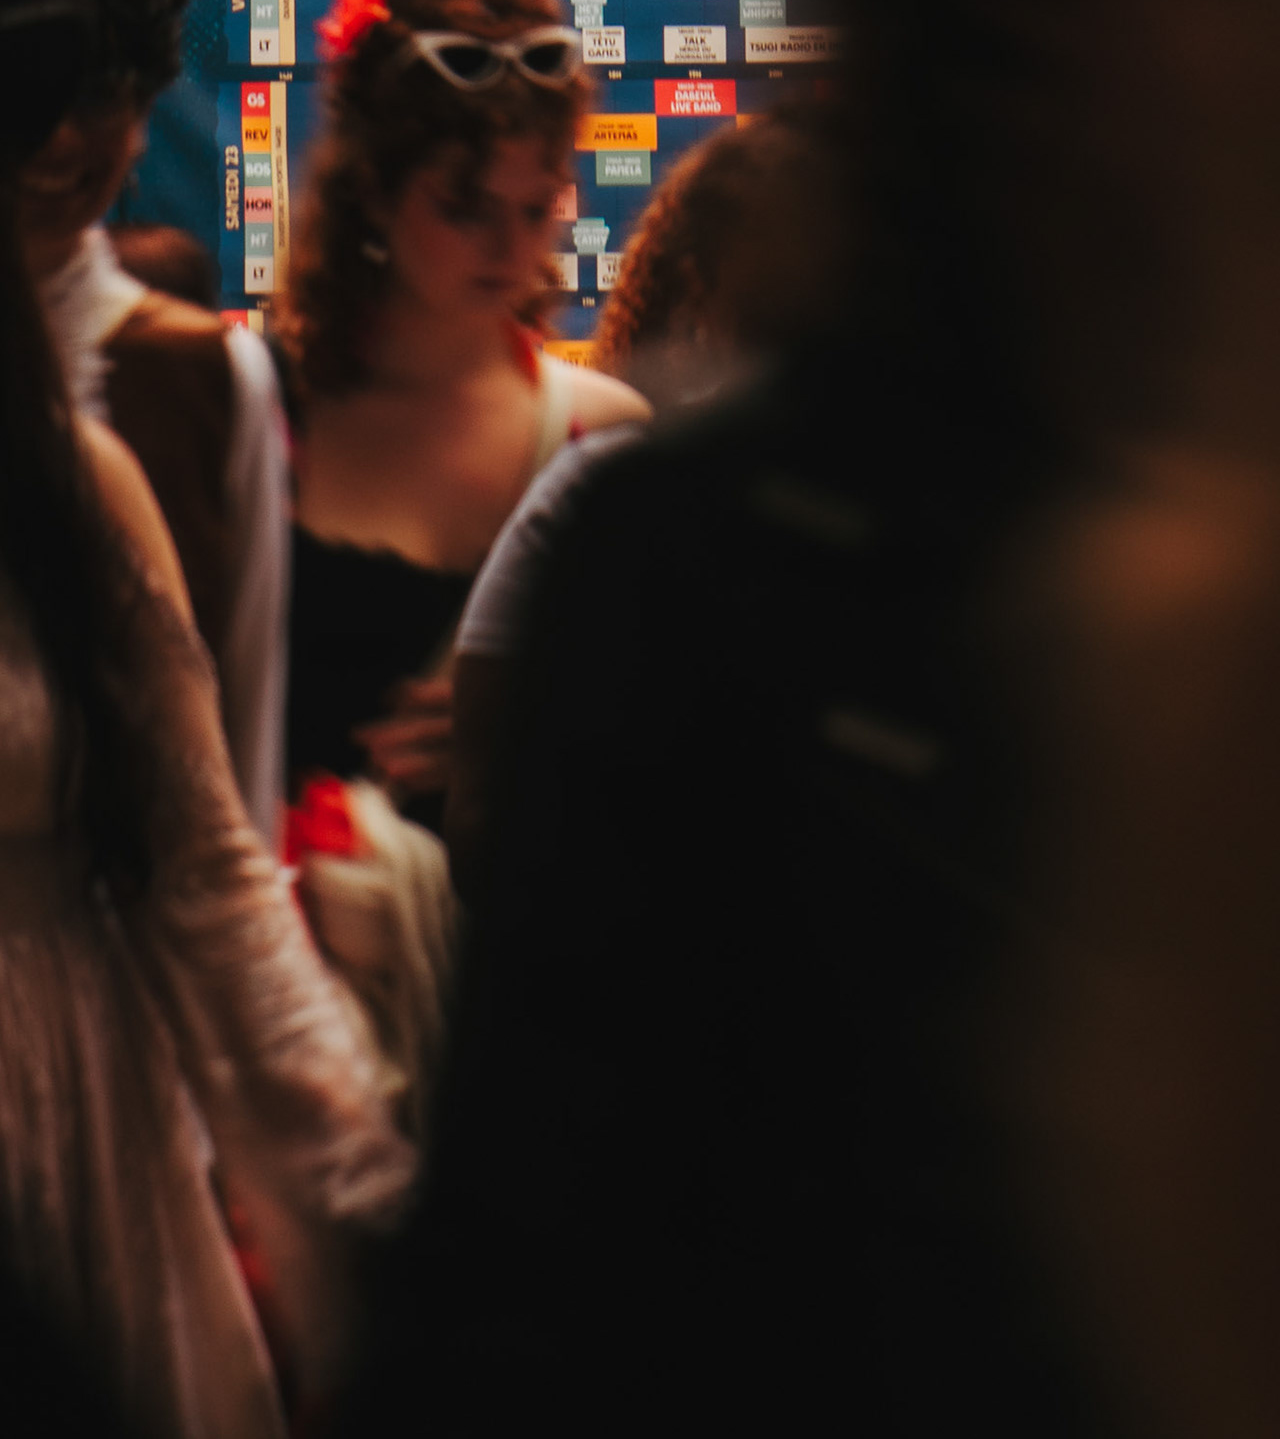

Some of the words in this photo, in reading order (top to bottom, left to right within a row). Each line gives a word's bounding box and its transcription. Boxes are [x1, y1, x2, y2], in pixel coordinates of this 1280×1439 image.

[256, 5, 273, 19] NT
[259, 39, 271, 52] LT
[684, 36, 706, 45] TALK
[750, 42, 778, 52] TSUGI
[780, 42, 811, 52] RADIO
[246, 93, 266, 107] GS
[670, 101, 693, 112] LIVE
[694, 102, 722, 114] BAND
[245, 128, 268, 141] REV
[594, 131, 638, 141] ARTEMAS
[245, 199, 272, 211] HOR
[253, 267, 264, 279] LT
